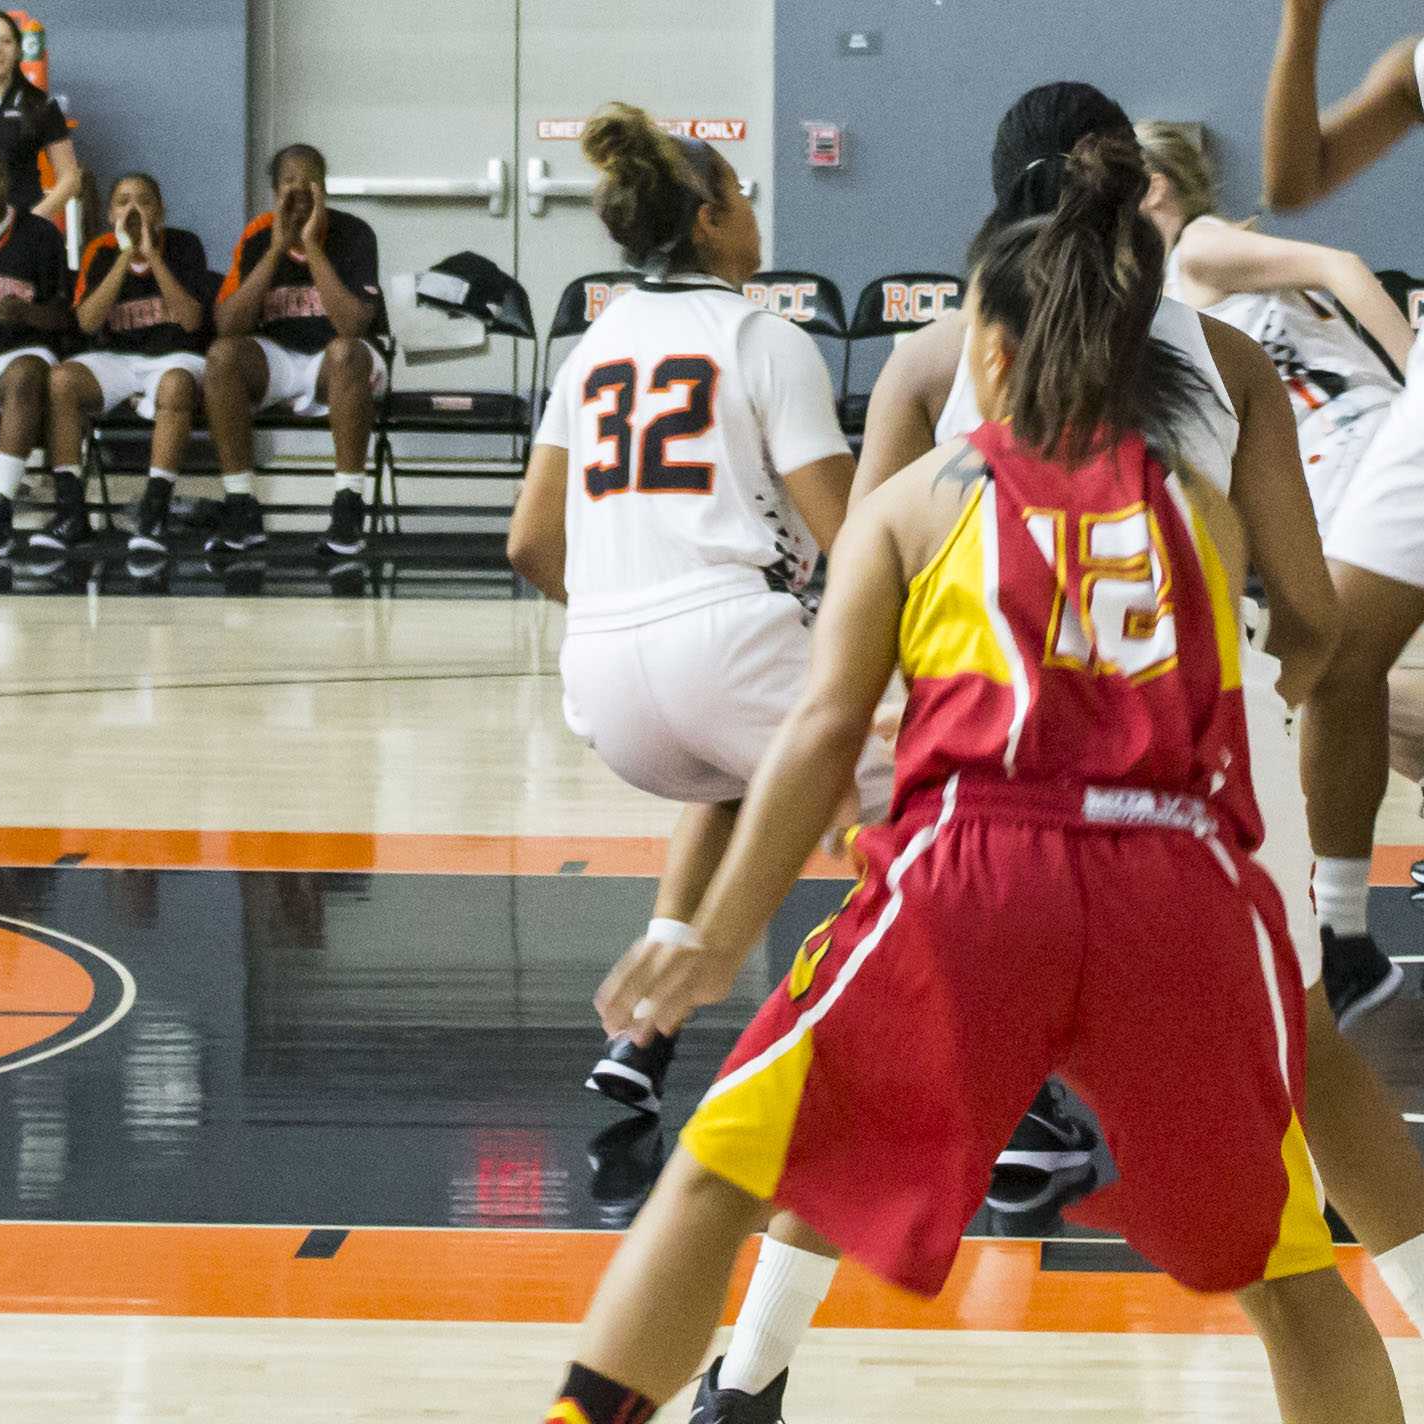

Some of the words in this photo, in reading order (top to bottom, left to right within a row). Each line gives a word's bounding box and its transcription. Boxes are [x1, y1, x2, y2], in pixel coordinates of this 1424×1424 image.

[695, 121, 744, 139] ONLY
[743, 282, 817, 322] RCC
[882, 282, 959, 323] RCC
[582, 354, 720, 501] 32
[1022, 501, 1179, 687] 12
